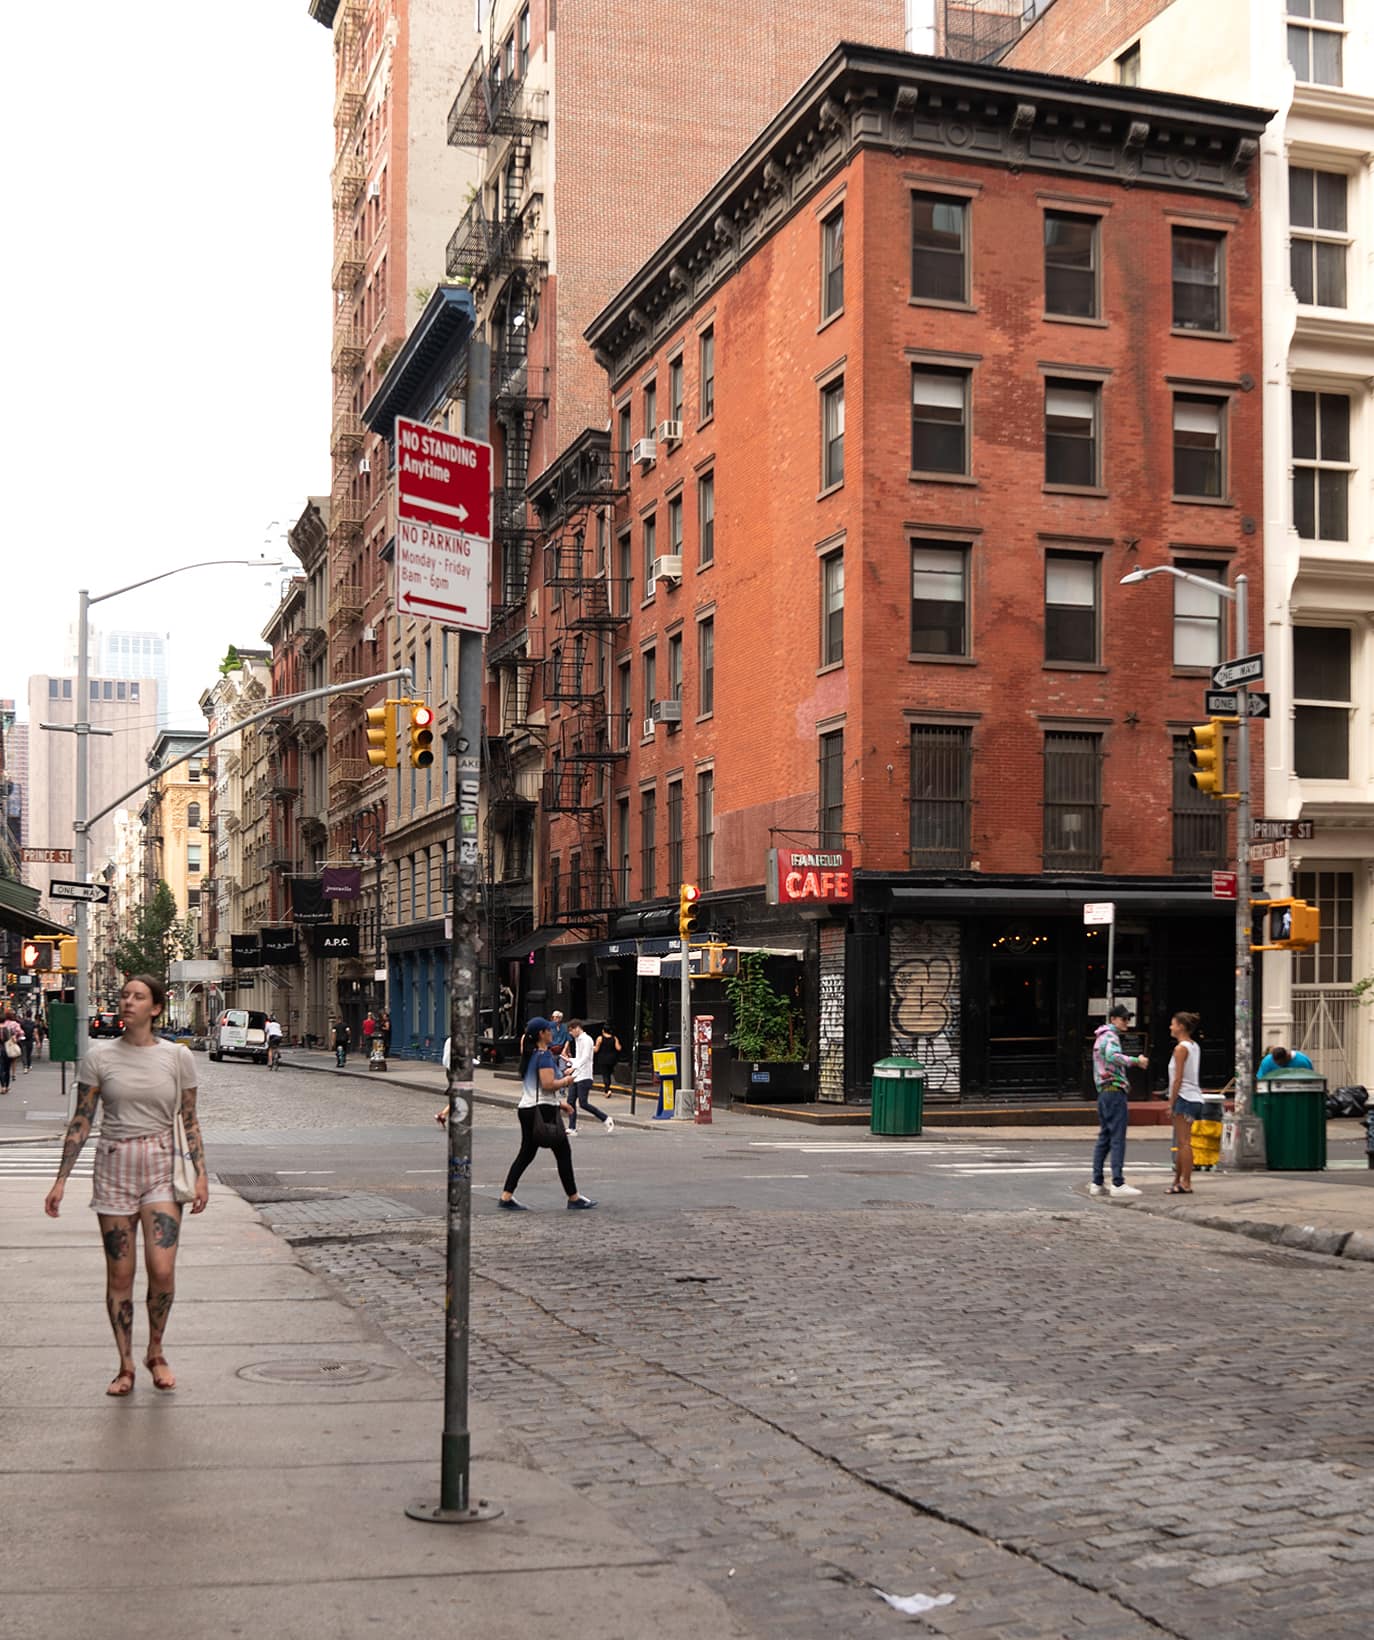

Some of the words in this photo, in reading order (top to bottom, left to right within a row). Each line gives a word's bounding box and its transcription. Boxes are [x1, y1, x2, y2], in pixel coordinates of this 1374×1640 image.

[402, 429, 419, 451] NO
[421, 435, 478, 469] STANDING
[402, 454, 451, 483] Anytime
[402, 524, 418, 544] NO
[421, 530, 472, 557] PARKING
[402, 548, 437, 571] Monday
[444, 559, 472, 581] Friday
[401, 566, 422, 585] 8am
[429, 573, 449, 591] 6pm
[1217, 669, 1233, 682] ONE
[1239, 663, 1257, 676] WAY
[1214, 698, 1233, 709] ONE
[1248, 700, 1261, 710] AY
[1254, 823, 1293, 838] PRINCE
[1297, 823, 1312, 838] ST
[23, 849, 56, 862] PRINCE
[59, 850, 70, 863] ST
[57, 886, 74, 895] ONE
[83, 889, 101, 897] WAY
[785, 871, 849, 898] CAFE
[324, 938, 350, 947] A.P.C.
